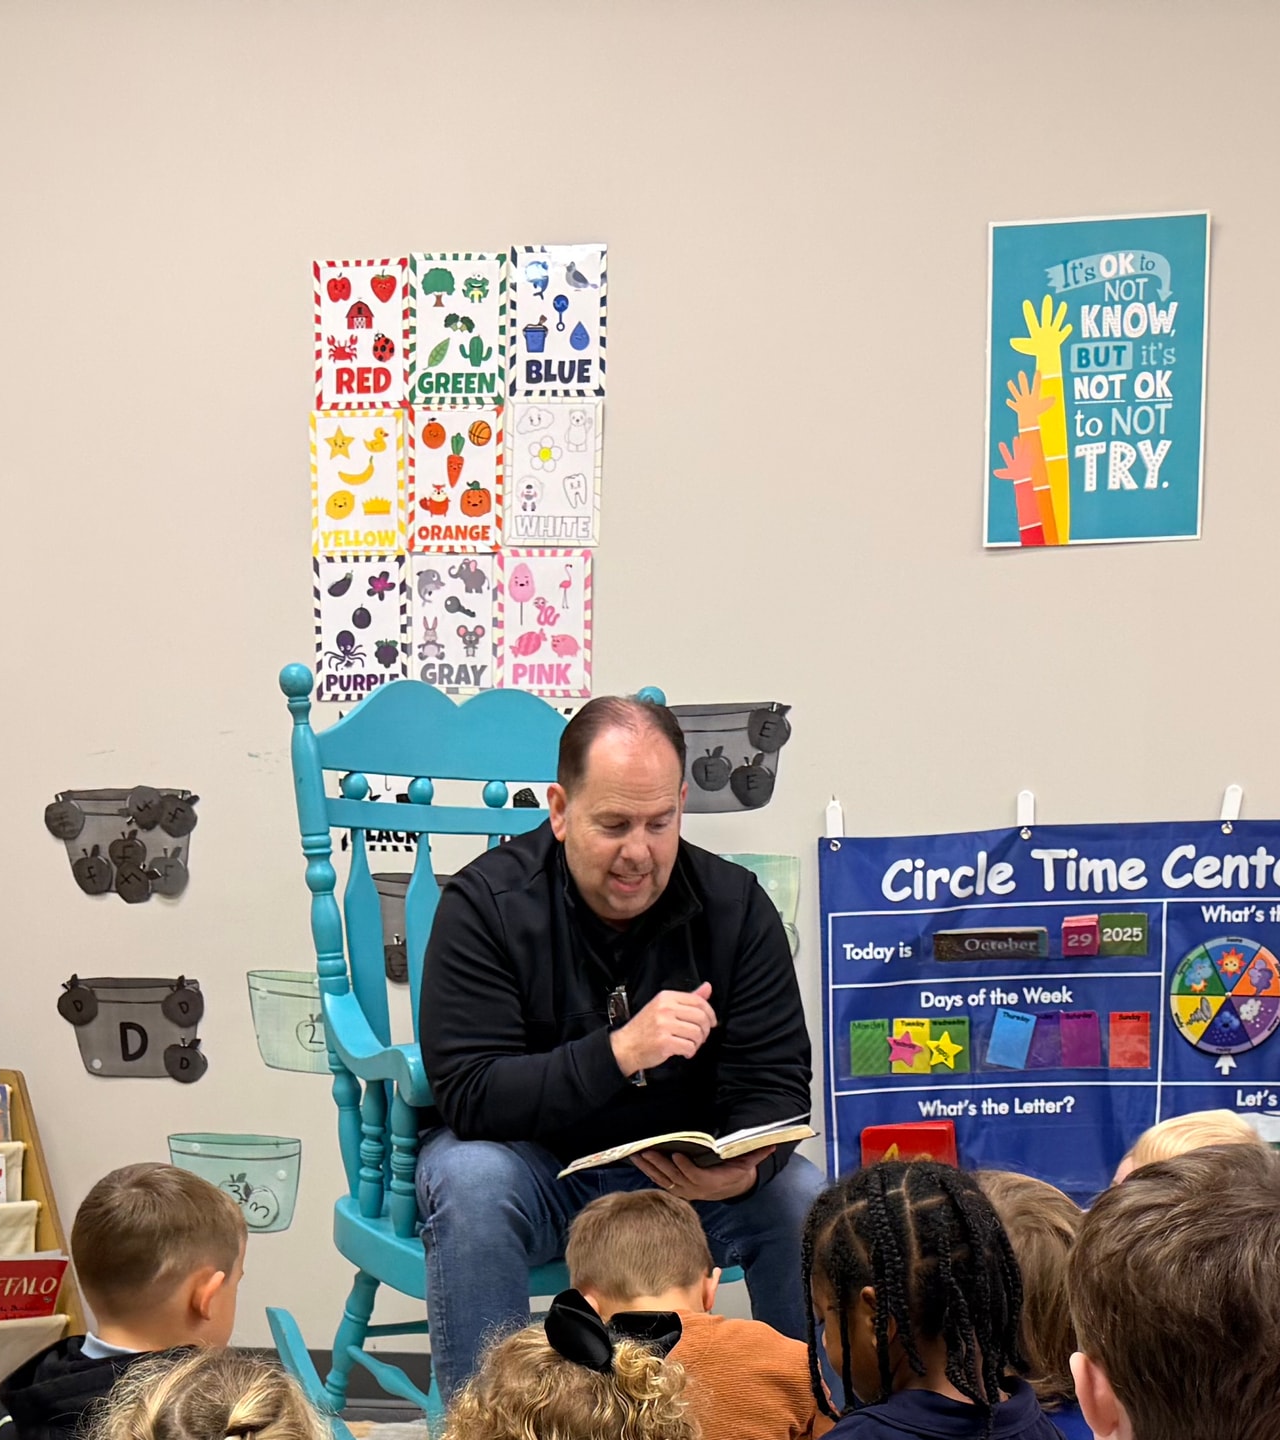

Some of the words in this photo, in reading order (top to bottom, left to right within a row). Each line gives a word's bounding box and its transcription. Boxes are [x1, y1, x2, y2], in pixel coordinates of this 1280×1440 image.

[1062, 259, 1097, 289] It's
[1099, 252, 1135, 279] OK
[1140, 254, 1156, 272] to
[1104, 278, 1149, 302] NOT
[1080, 302, 1179, 338] KNOW,
[1076, 345, 1128, 369] BUT
[1141, 345, 1177, 366] it's
[335, 366, 392, 394] RED
[417, 372, 497, 394] GREEN
[525, 359, 593, 385] BLUE
[1073, 374, 1128, 400] NOT
[1134, 370, 1174, 400] OK
[1074, 410, 1104, 437] to
[1111, 404, 1173, 436] NOT
[1074, 440, 1173, 492] TRY.
[417, 525, 491, 542] ORANGE
[514, 515, 592, 539] WHITE
[321, 530, 396, 548] YELLOW
[420, 663, 488, 686] GRAY
[511, 663, 572, 686] PINK
[759, 720, 778, 739] E
[703, 764, 715, 782] E
[746, 774, 760, 791] E
[881, 850, 1017, 902] Circle
[1030, 848, 1149, 894] Time
[1201, 905, 1266, 924] What's
[842, 942, 895, 964] Today
[899, 941, 913, 958] is
[963, 937, 1038, 953] October
[1066, 932, 1094, 948] 29
[1102, 926, 1144, 943] 2025
[920, 990, 964, 1009] Days
[967, 989, 987, 1007] of
[989, 988, 1019, 1006] the
[1022, 986, 1074, 1005] Week
[119, 1021, 149, 1062] D
[304, 1024, 325, 1045] 2
[179, 1056, 190, 1070] D
[918, 1099, 978, 1117] What's
[981, 1098, 1009, 1116] the
[1014, 1096, 1076, 1115] Letter?
[1236, 1089, 1278, 1107] Let's
